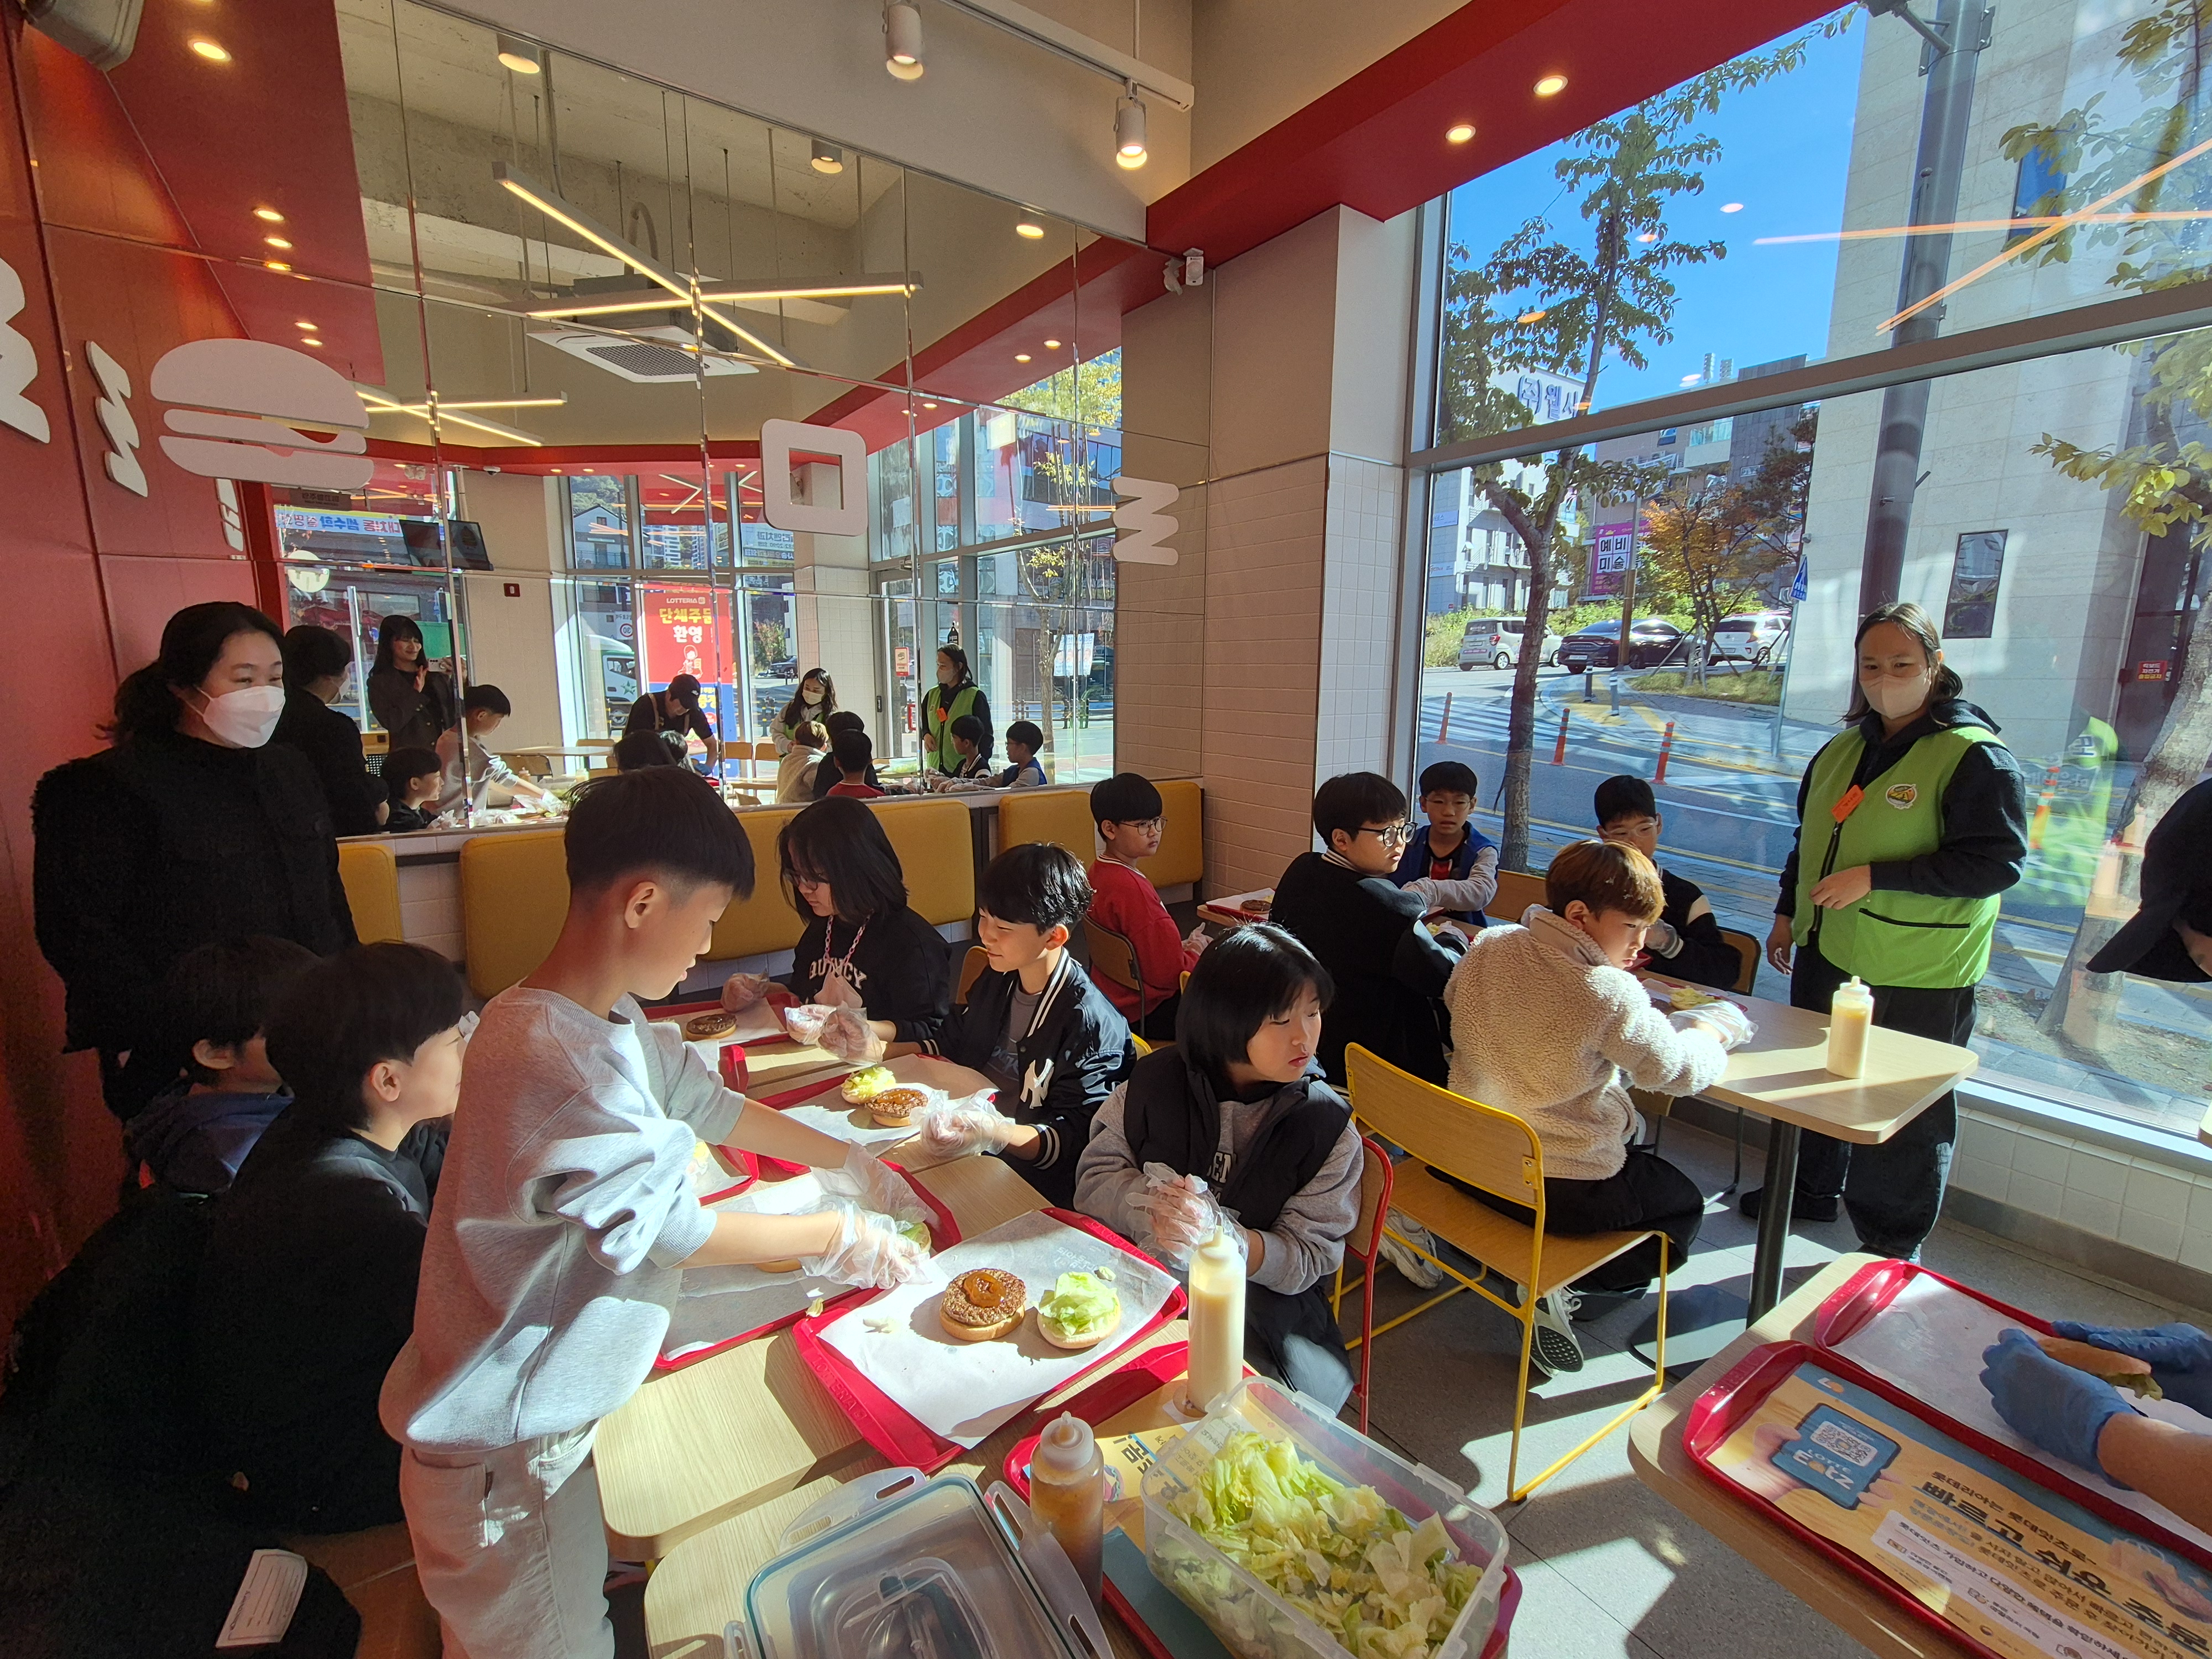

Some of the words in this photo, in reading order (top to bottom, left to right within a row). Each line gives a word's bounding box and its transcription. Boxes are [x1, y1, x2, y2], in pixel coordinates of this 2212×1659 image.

[1600, 537, 1627, 552] 예비
[1599, 556, 1625, 570] 미술
[672, 625, 703, 644] 환영
[1020, 1058, 1055, 1109] NY
[1922, 1481, 2025, 1548] 빠르고
